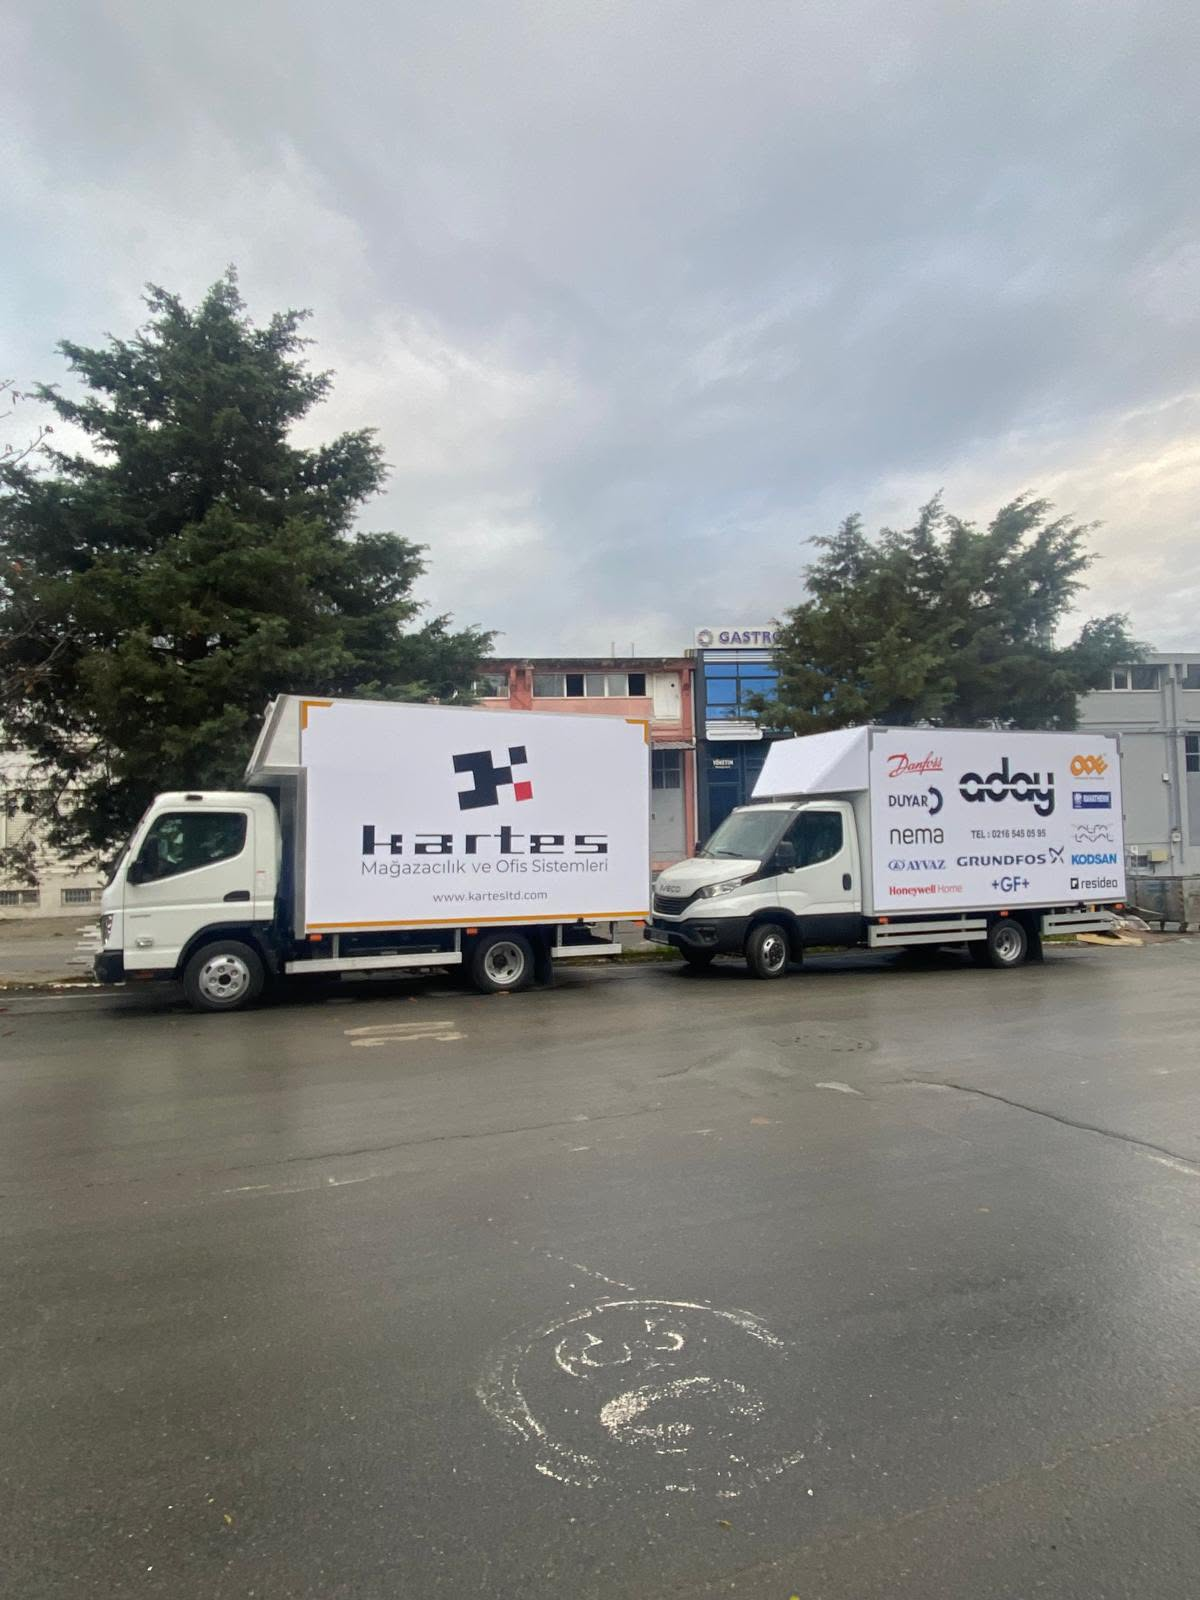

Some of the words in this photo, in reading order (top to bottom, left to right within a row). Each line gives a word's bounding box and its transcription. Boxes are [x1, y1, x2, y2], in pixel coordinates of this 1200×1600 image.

[887, 751, 943, 777] Danfoss
[959, 757, 1055, 817] aday
[888, 795, 928, 807] DUYAR
[362, 825, 608, 855] kartes
[890, 828, 944, 845] nema
[971, 830, 986, 839] TEL
[992, 830, 1010, 839] 0216
[1011, 829, 1025, 838] 545
[1037, 829, 1047, 838] 95
[907, 860, 946, 871] AYVAZ
[957, 855, 1046, 867] GRUNDFOS
[1071, 854, 1117, 865] KODSAN
[361, 860, 466, 878] Mağazacılık
[472, 861, 491, 873] ve
[496, 859, 528, 873] Ofis
[532, 858, 608, 872] Sistemleri
[1081, 877, 1118, 889] resideo
[889, 885, 936, 896] Honeywell
[937, 884, 963, 894] Home
[433, 891, 548, 903] www.kartesltd.com
